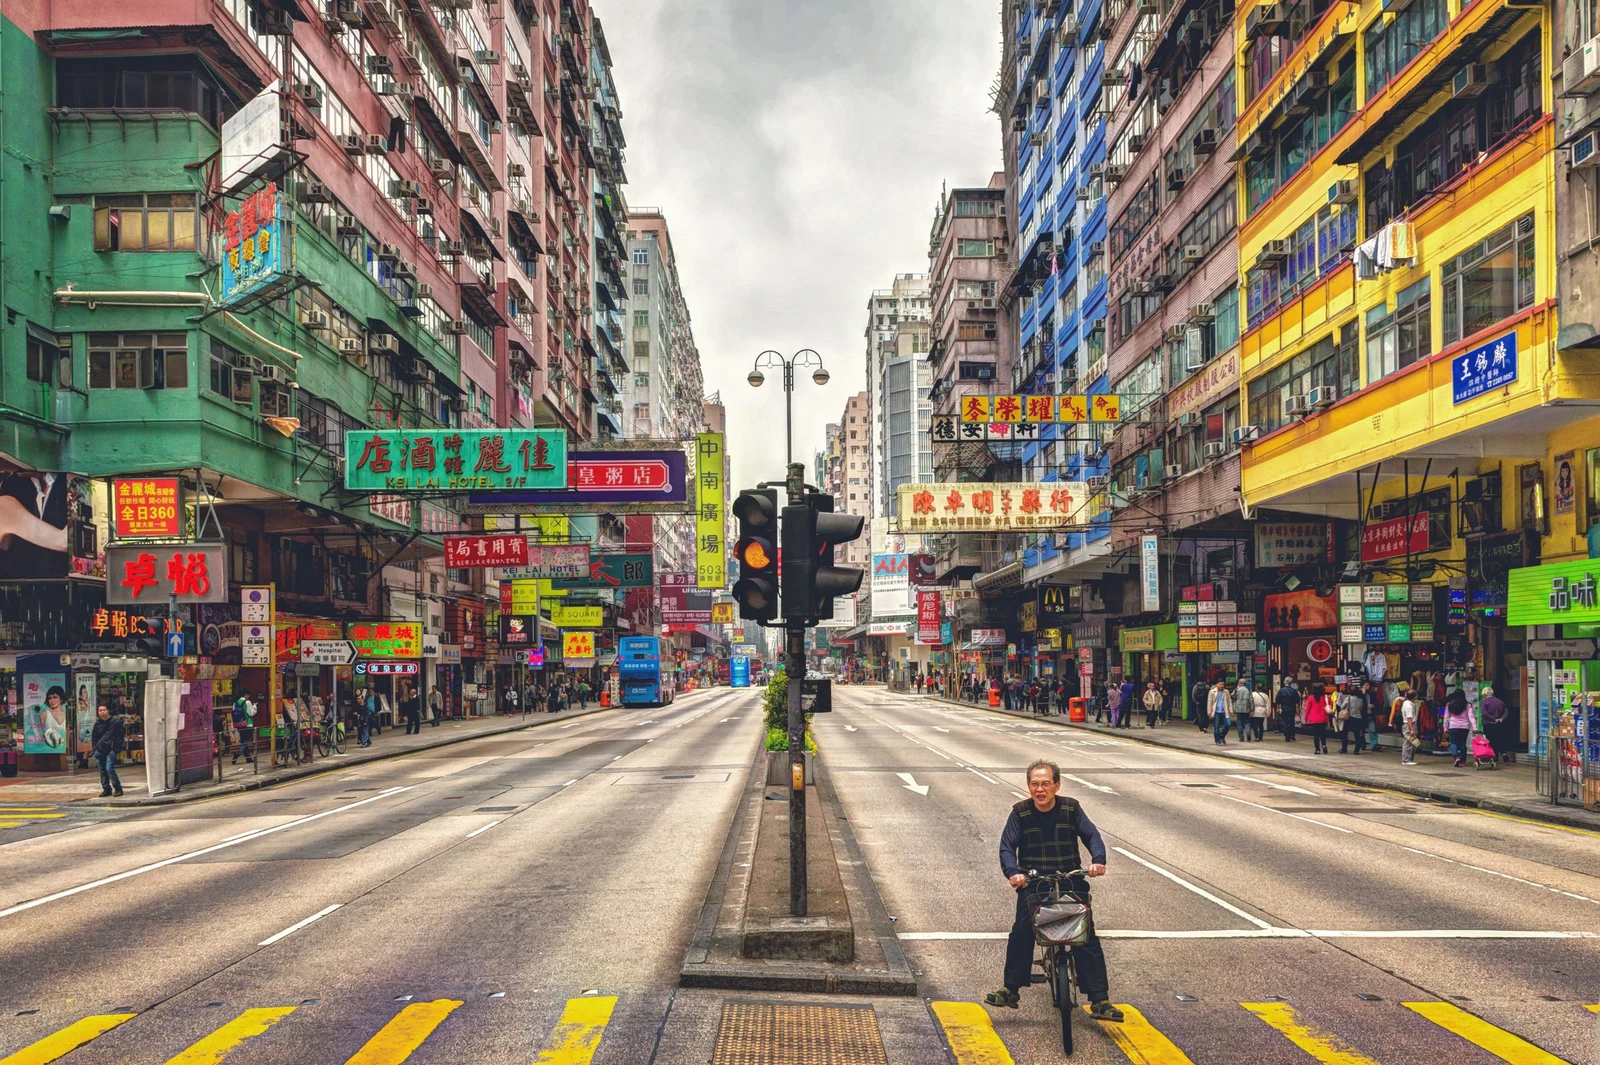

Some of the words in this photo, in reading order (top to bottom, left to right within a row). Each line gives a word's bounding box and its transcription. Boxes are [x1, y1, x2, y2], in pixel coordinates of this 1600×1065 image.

[1061, 396, 1086, 421] 風水
[1094, 396, 1118, 420] 命理
[386, 477, 409, 488] KEI
[416, 477, 440, 488] LAI
[449, 476, 495, 488] HOTEL
[505, 476, 527, 488] 2/F
[700, 439, 719, 554] 中南廣場
[549, 565, 580, 573] HOTEL
[699, 565, 722, 575] 503
[1549, 572, 1595, 610] 品味
[922, 592, 936, 620] 威尼斯
